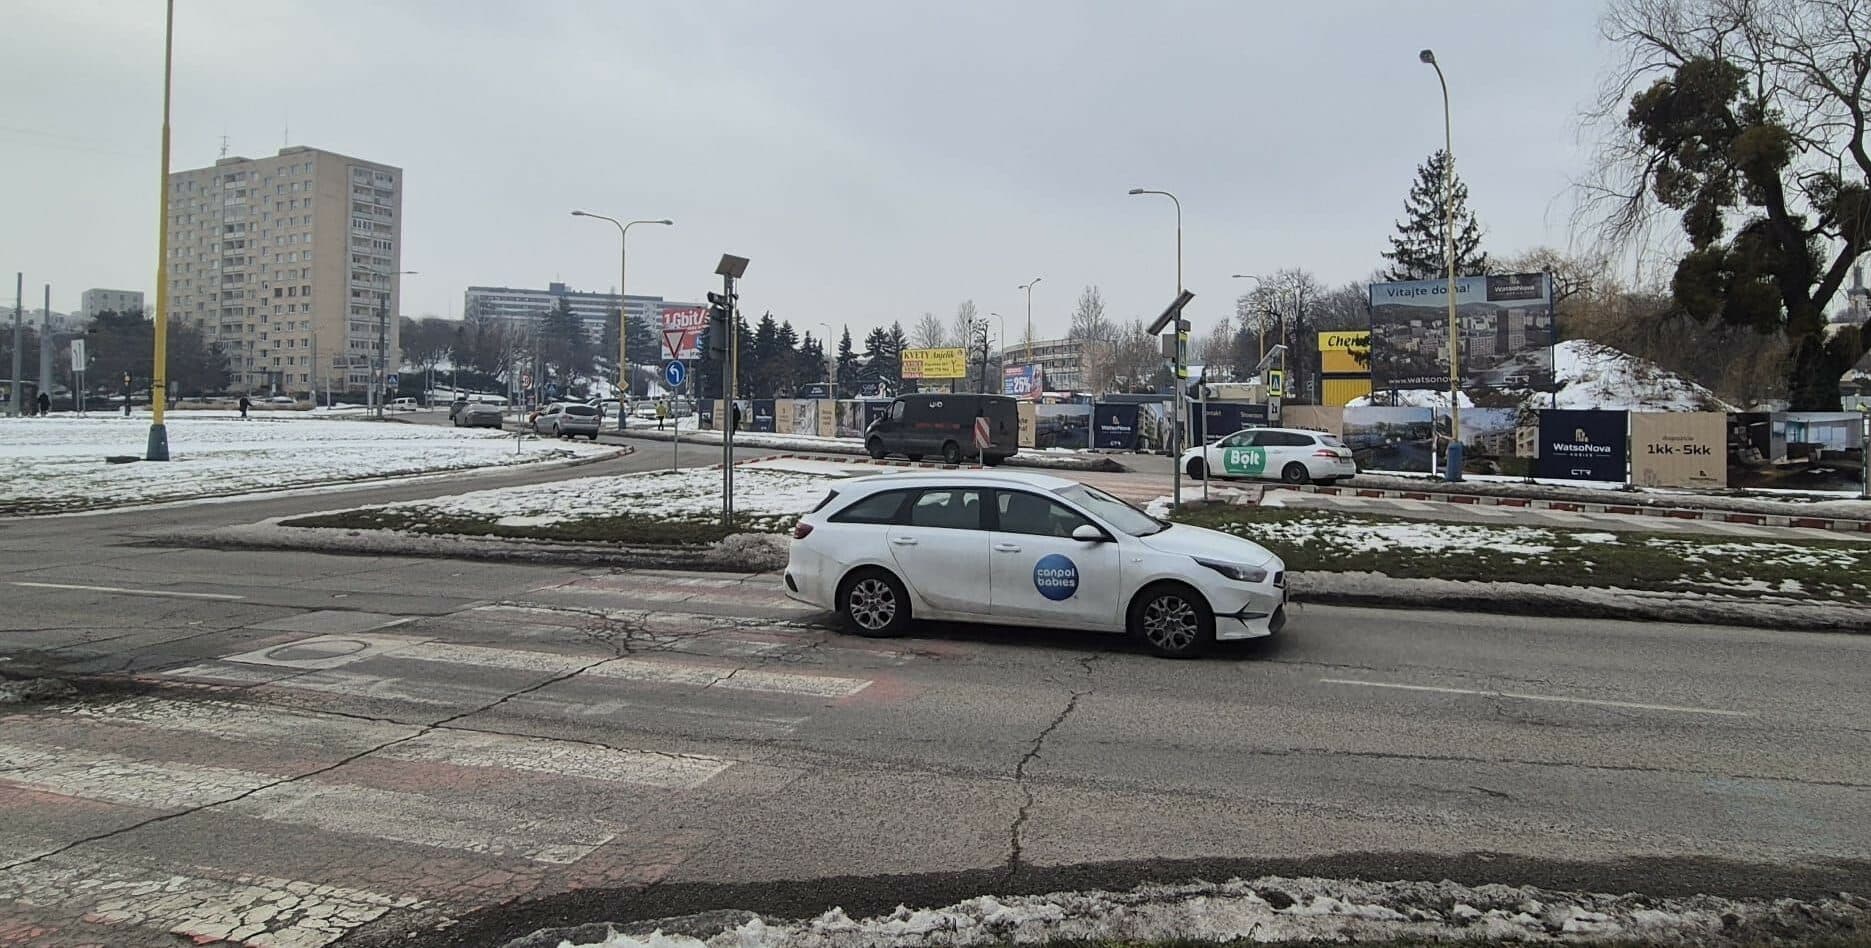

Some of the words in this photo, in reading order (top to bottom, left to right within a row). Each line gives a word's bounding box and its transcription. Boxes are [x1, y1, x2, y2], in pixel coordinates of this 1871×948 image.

[1387, 287, 1428, 298] Vitajte
[1494, 285, 1535, 293] WatsoNova
[904, 351, 929, 359] KVETY
[1014, 376, 1031, 392] 25%
[1553, 442, 1611, 453] WatsoNova
[1230, 450, 1260, 466] Bolt
[1037, 568, 1075, 578] canpol
[1037, 577, 1075, 587] babies
